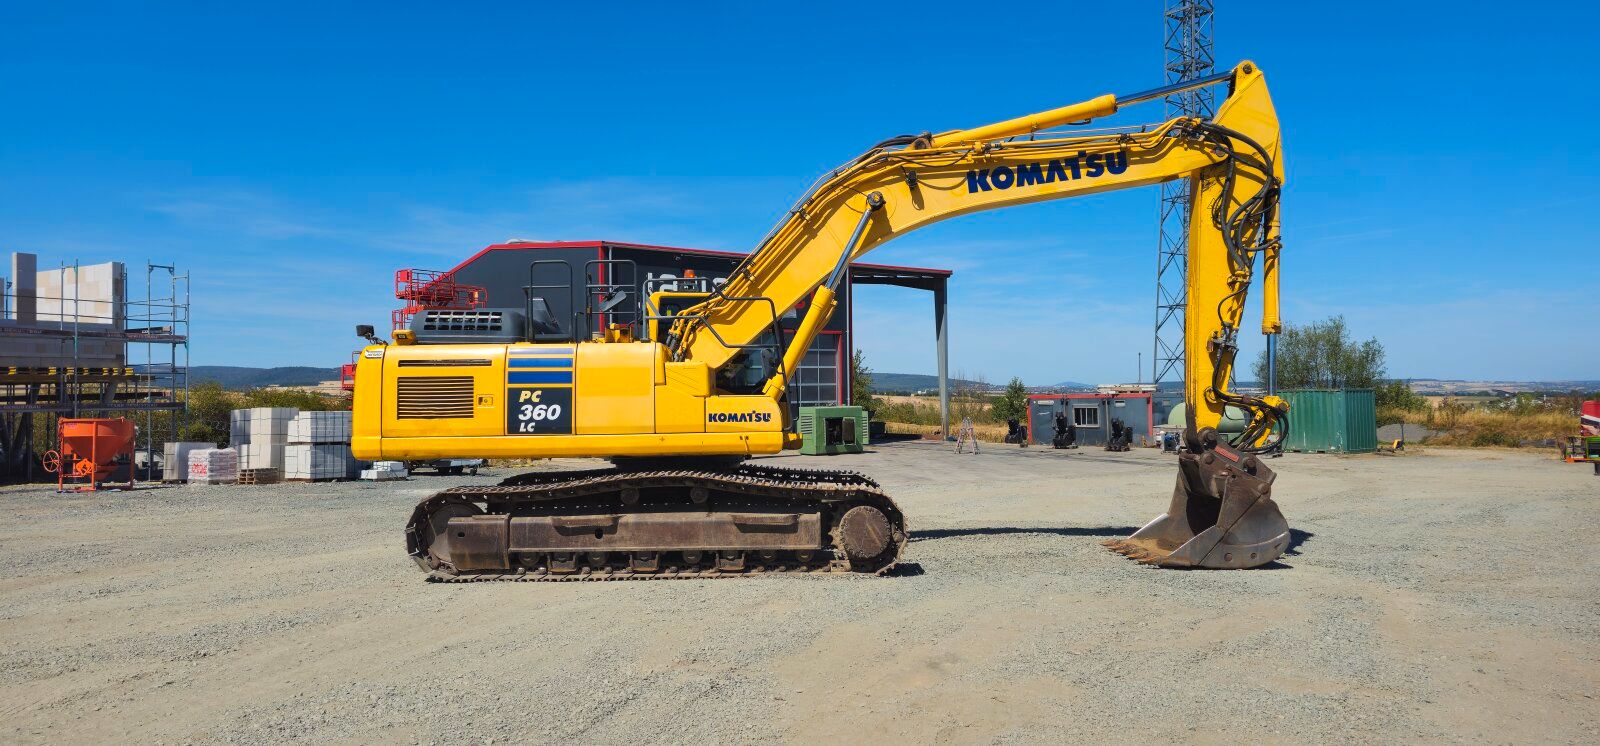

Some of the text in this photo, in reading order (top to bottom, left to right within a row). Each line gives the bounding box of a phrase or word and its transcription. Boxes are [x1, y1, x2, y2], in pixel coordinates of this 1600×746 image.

[966, 150, 1129, 194] KOMATSU
[518, 390, 542, 402] PC
[518, 404, 562, 420] 360
[708, 410, 772, 422] KOMATSU
[519, 422, 536, 432] LC
